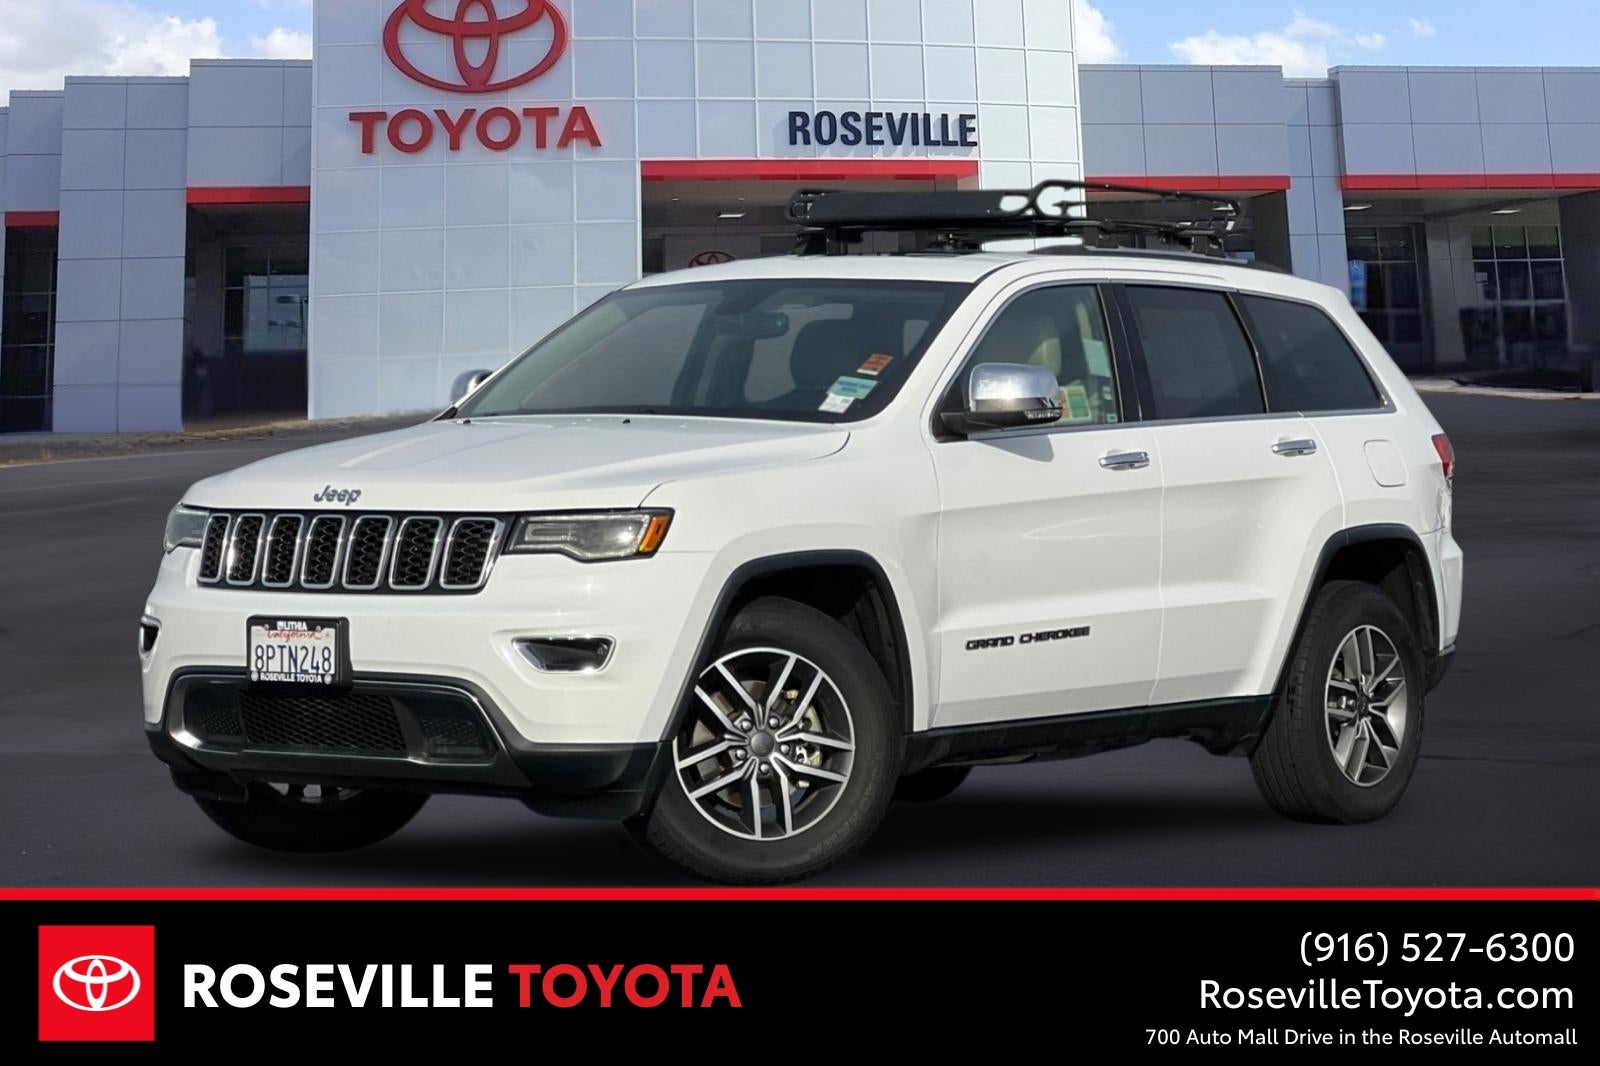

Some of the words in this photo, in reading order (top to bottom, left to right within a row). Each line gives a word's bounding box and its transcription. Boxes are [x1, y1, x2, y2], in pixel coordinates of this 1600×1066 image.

[349, 106, 602, 154] TOYOTA
[788, 111, 978, 147] ROSEVILLE
[313, 485, 362, 506] Jeep
[965, 635, 1014, 651] GRAND
[1018, 626, 1091, 644] CHEROKEE
[255, 644, 332, 674] 8PTN248
[260, 673, 296, 682] ROSEVILLE
[296, 674, 323, 683] TOYOTA
